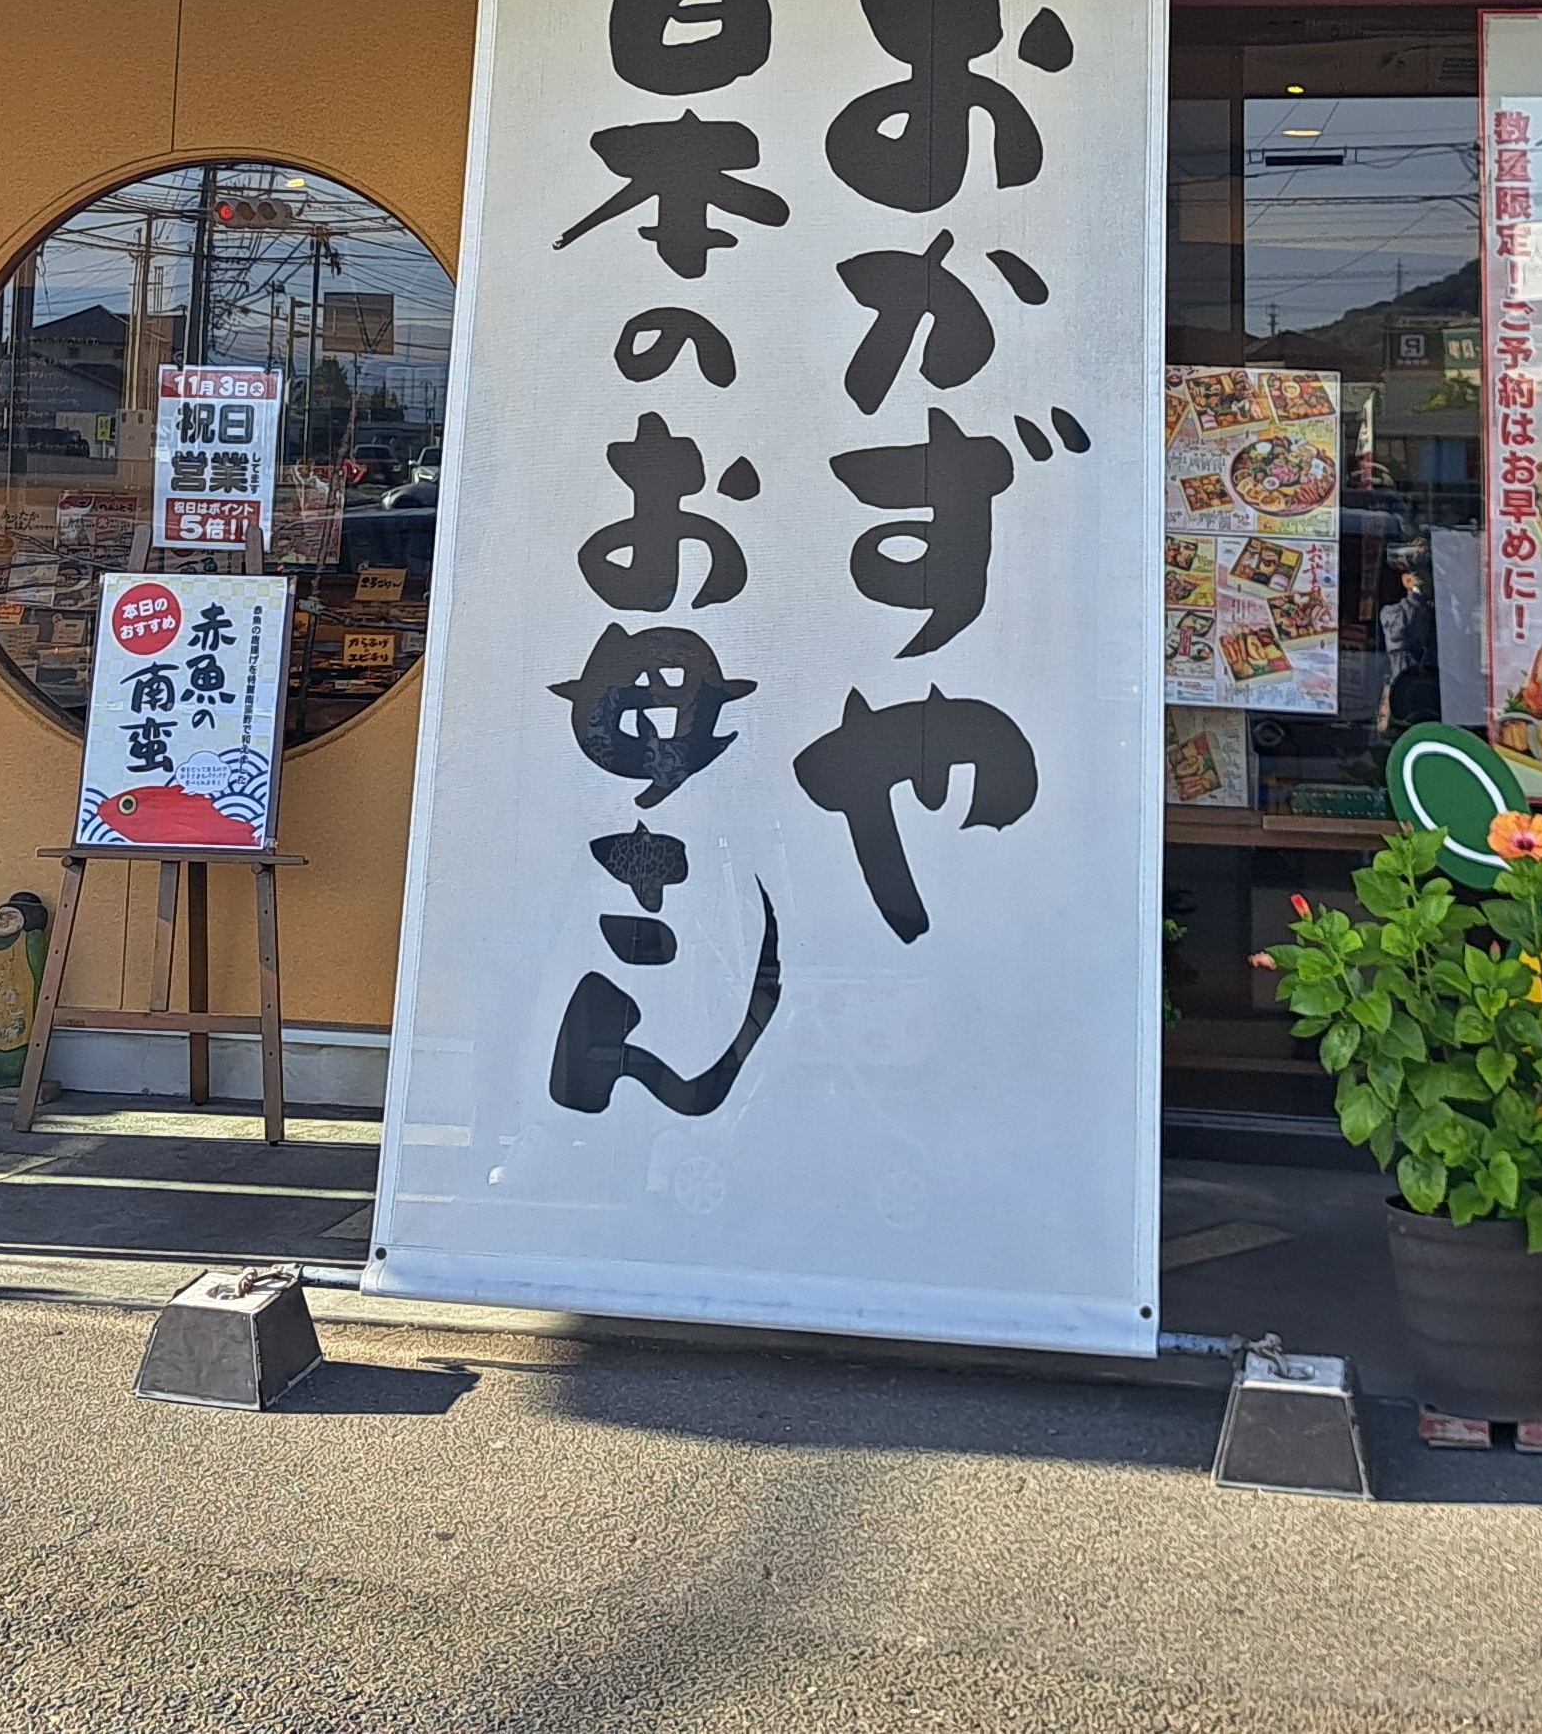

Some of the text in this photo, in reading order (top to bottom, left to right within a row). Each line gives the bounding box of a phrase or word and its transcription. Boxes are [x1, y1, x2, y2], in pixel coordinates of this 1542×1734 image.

[176, 401, 255, 444] 祝日
[171, 450, 249, 493] 営業
[174, 501, 254, 515] 祝日はポイント
[120, 616, 176, 640] おすすめ
[122, 598, 168, 619] 本日の
[180, 602, 237, 730] 赤魚の
[118, 661, 180, 773] 南蛮
